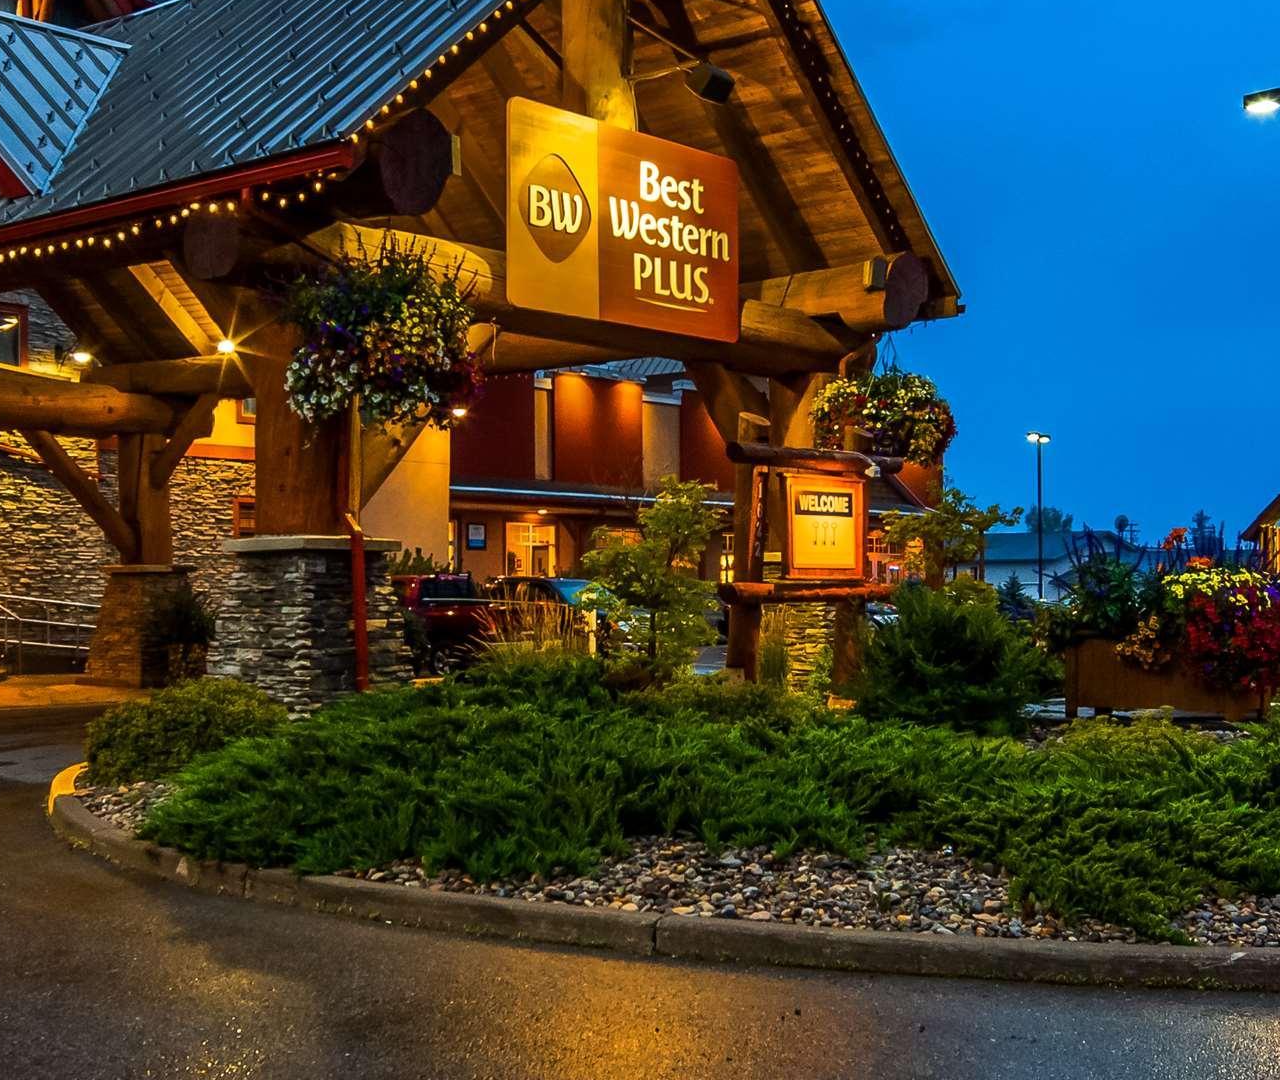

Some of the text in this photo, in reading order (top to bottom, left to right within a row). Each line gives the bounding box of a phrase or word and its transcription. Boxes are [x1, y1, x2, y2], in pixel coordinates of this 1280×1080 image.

[528, 184, 583, 234] BW
[639, 160, 705, 215] Best
[608, 195, 730, 262] Western
[633, 253, 710, 304] PLUS
[799, 494, 849, 513] WELCOME
